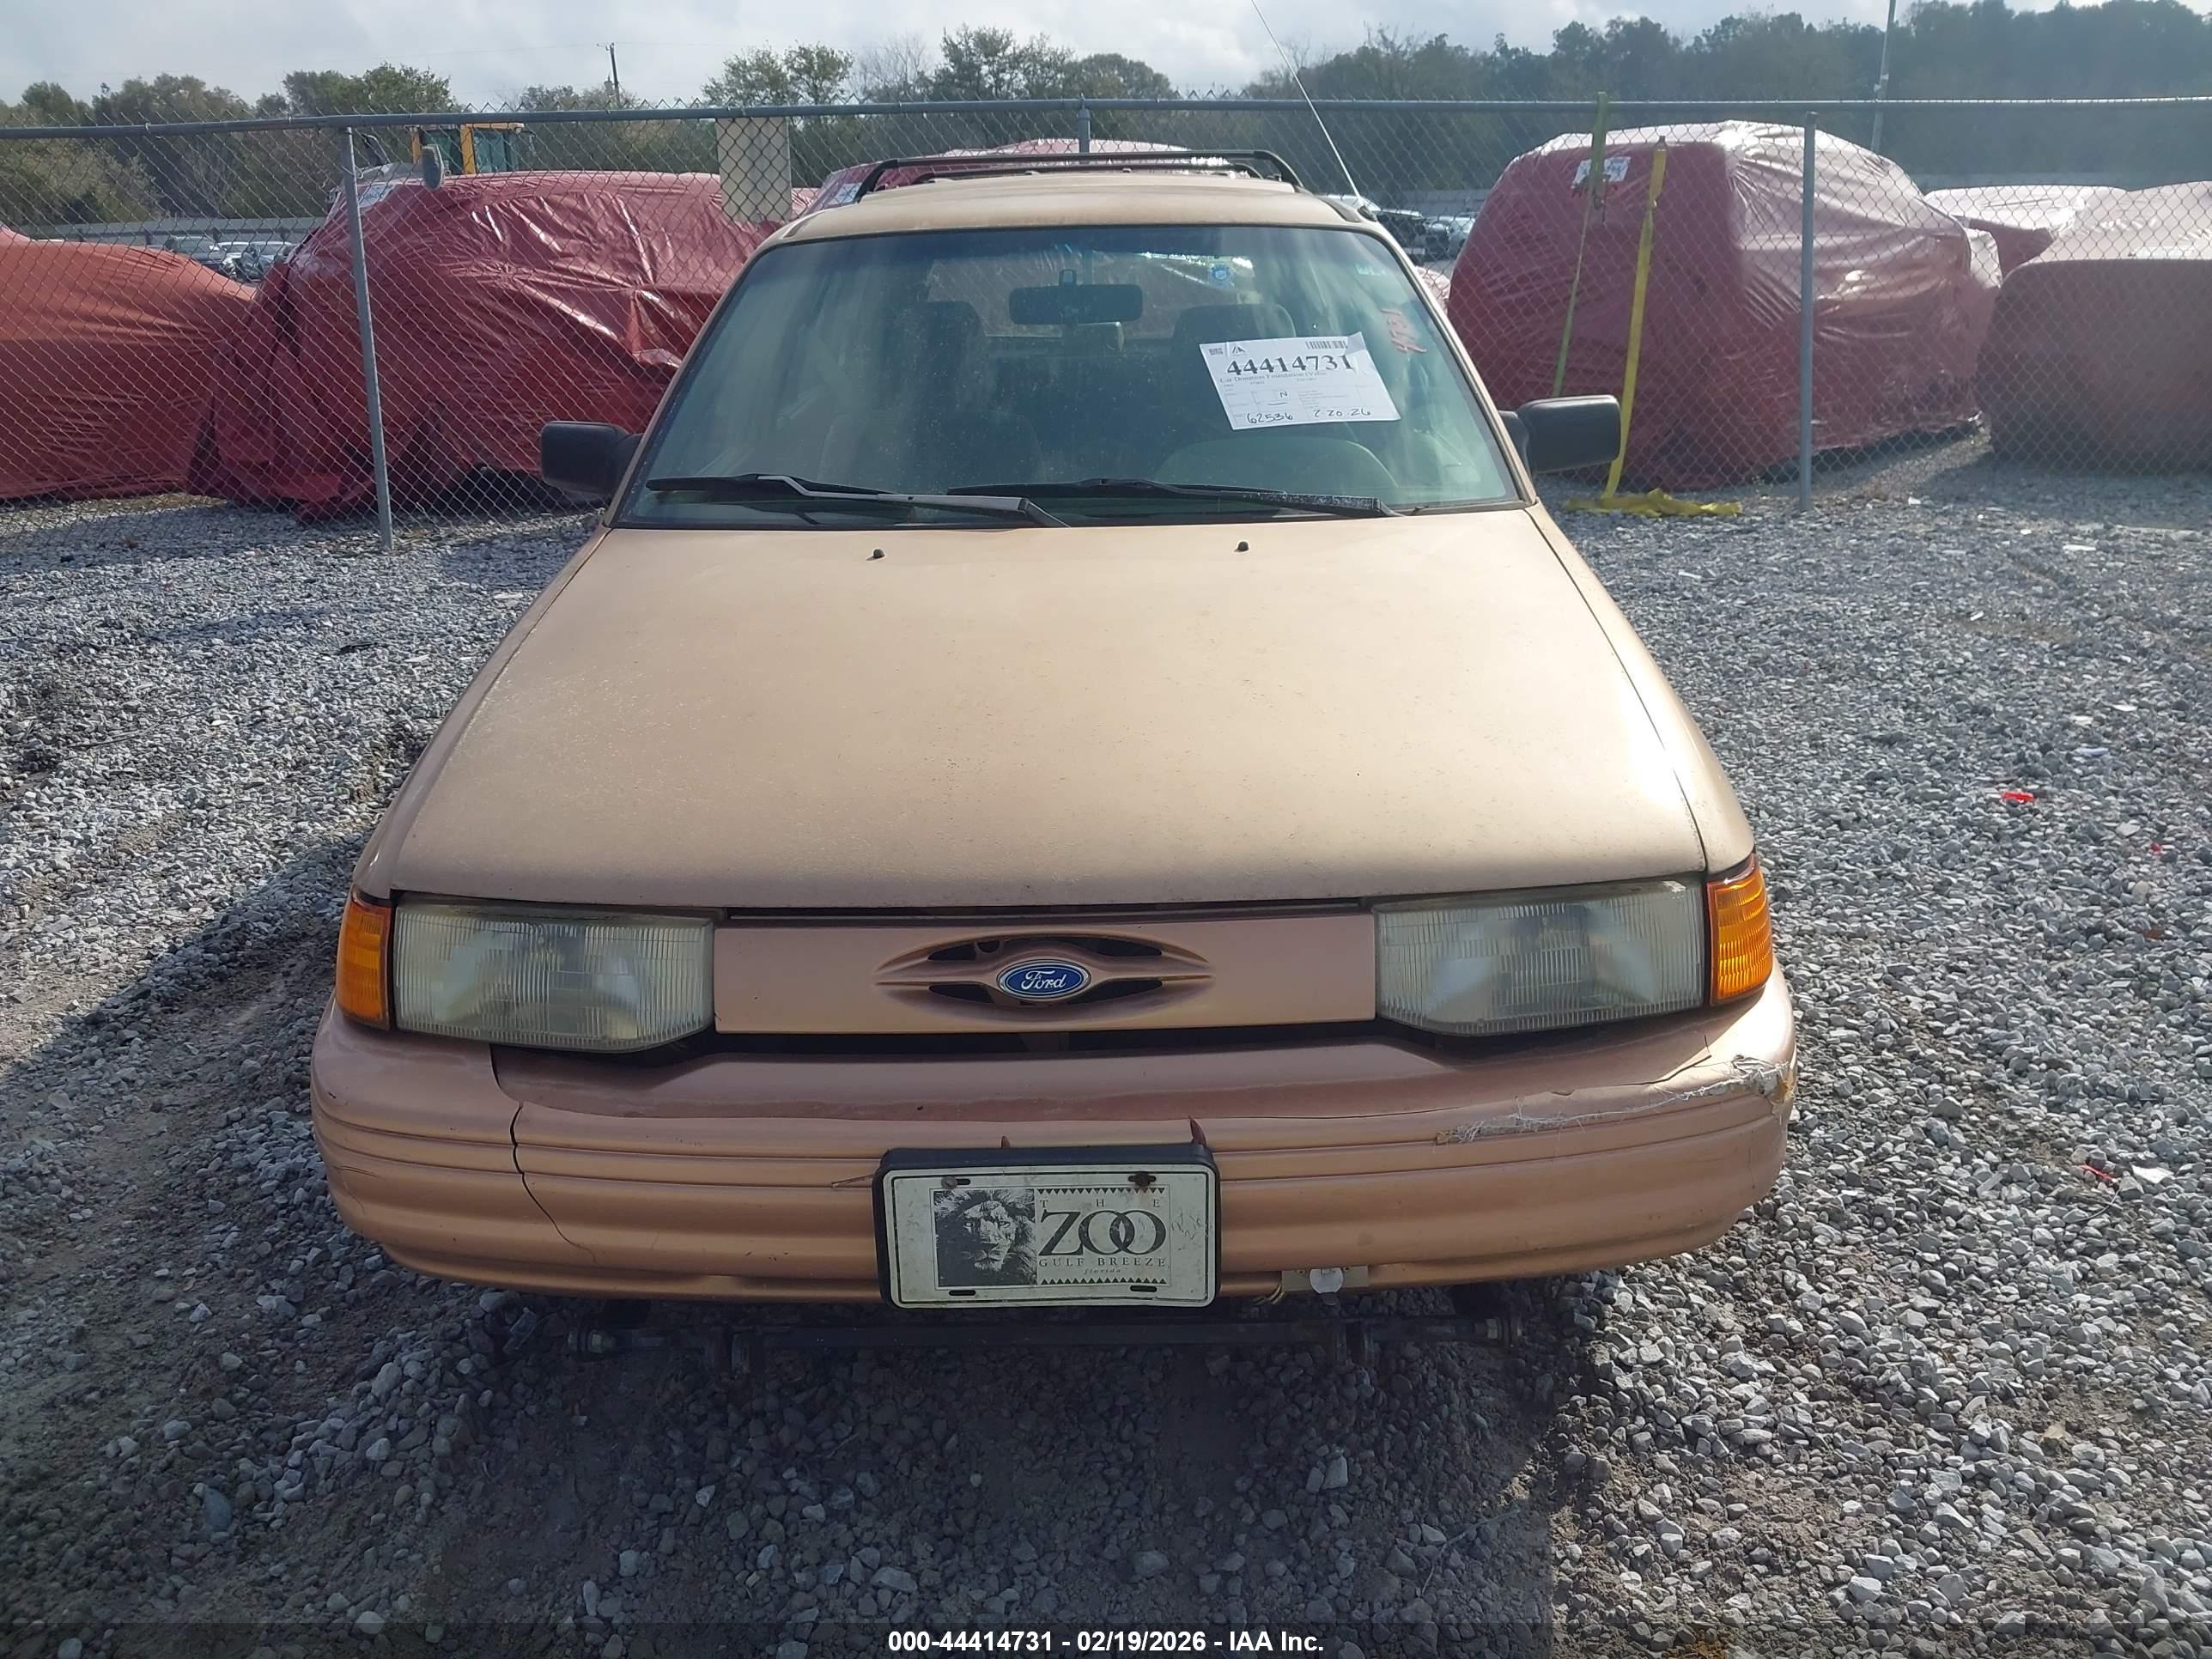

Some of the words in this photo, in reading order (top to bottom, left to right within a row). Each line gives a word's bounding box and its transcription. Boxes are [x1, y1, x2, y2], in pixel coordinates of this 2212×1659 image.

[1227, 356, 1354, 376] 44414731
[1021, 969, 1066, 989] Ford
[1038, 1209, 1167, 1256] ZOO
[1039, 1258, 1085, 1267] GULF
[1097, 1257, 1166, 1267] BREEZE
